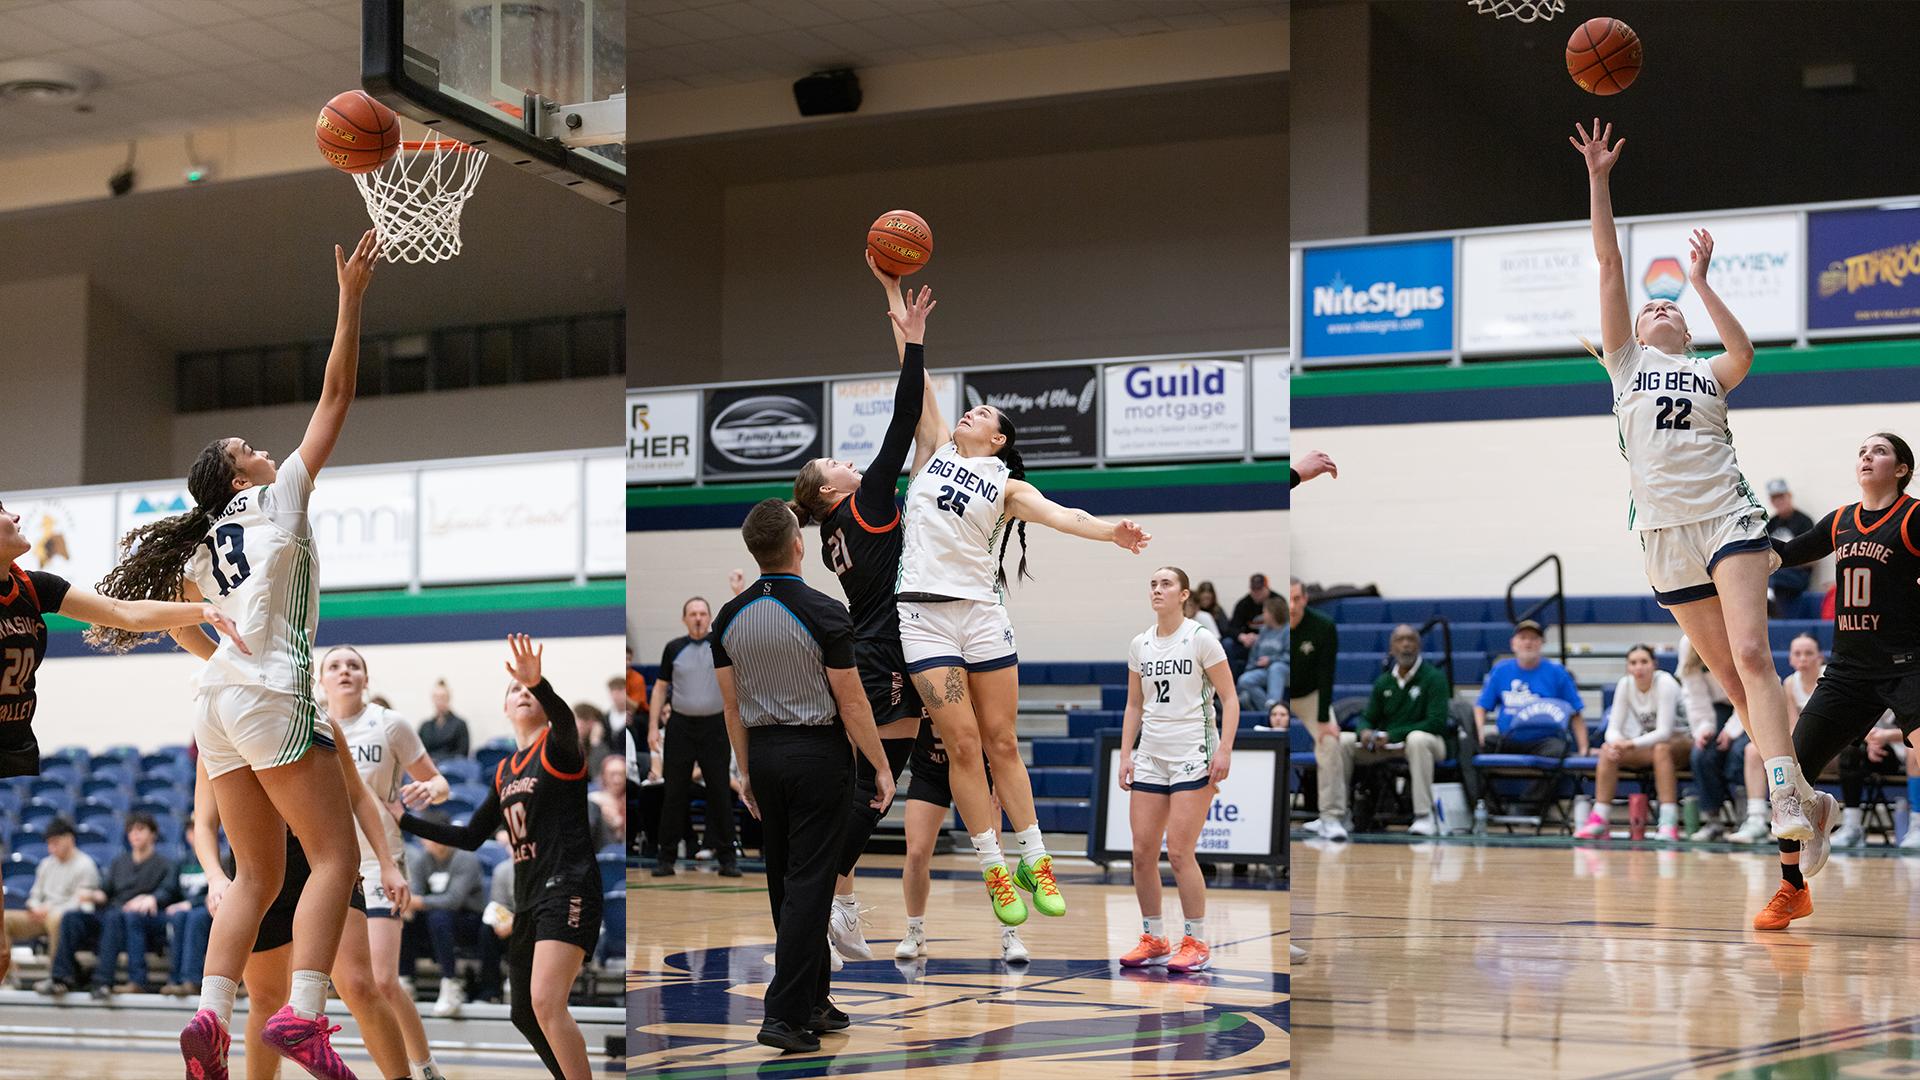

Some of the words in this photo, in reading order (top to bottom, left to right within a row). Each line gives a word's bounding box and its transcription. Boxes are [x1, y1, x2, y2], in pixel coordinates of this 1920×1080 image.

[1711, 252, 1789, 273] KYVIEW
[1844, 240, 1920, 294] TAPROO
[1313, 282, 1445, 317] NiteSigns
[1125, 362, 1224, 399] Guild
[1632, 372, 1660, 392] BIG
[1665, 372, 1718, 397] BEND
[1124, 401, 1225, 420] mortgage
[1656, 396, 1692, 430] 22
[626, 435, 689, 459] HER
[927, 458, 955, 478] BIG
[953, 466, 998, 503] BEND
[936, 485, 971, 517] 25
[200, 523, 251, 597] 13
[827, 527, 853, 577] 21
[1835, 541, 1894, 564] REASURE
[1843, 567, 1871, 608] 10
[1838, 614, 1880, 631] VALLEY
[0, 647, 35, 695] 20
[1155, 659, 1192, 676] BEND
[1154, 680, 1170, 703] 12
[349, 744, 382, 763] END
[502, 776, 538, 800] EASURE
[504, 801, 526, 845] 10
[1202, 828, 1231, 837] pson
